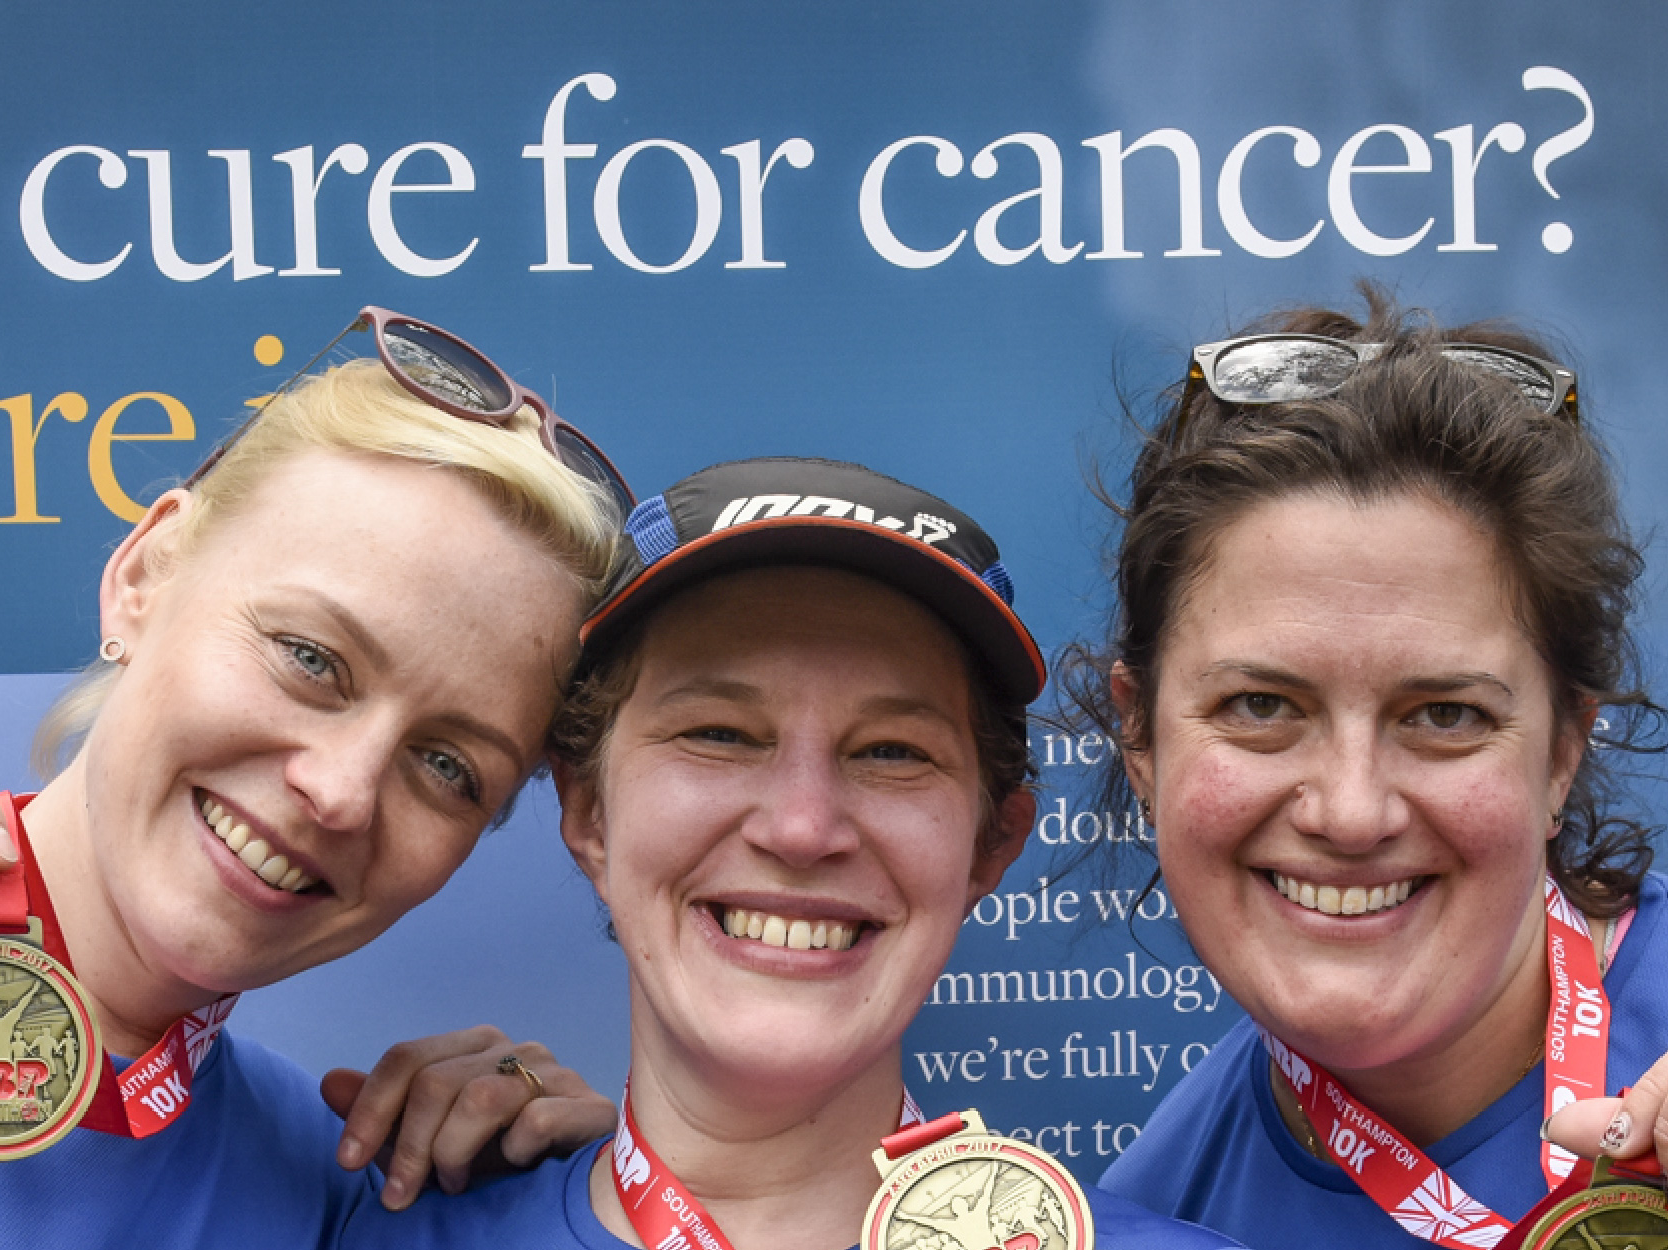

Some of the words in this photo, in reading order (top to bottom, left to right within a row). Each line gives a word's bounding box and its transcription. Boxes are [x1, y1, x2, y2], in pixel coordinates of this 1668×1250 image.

[18, 140, 480, 282] cure
[521, 71, 815, 275] for
[858, 65, 1596, 270] cancer?
[964, 876, 1081, 941] ople
[925, 951, 1224, 1013] mmunology
[1550, 933, 1571, 1063] SOUTHAMPTON
[1571, 979, 1604, 1039] 10K
[914, 1035, 1050, 1083] we're
[1059, 1029, 1172, 1092] fully
[139, 1068, 190, 1120] 10K
[1325, 1081, 1419, 1171] SOUTHAMPTON
[1327, 1117, 1376, 1176] 10K
